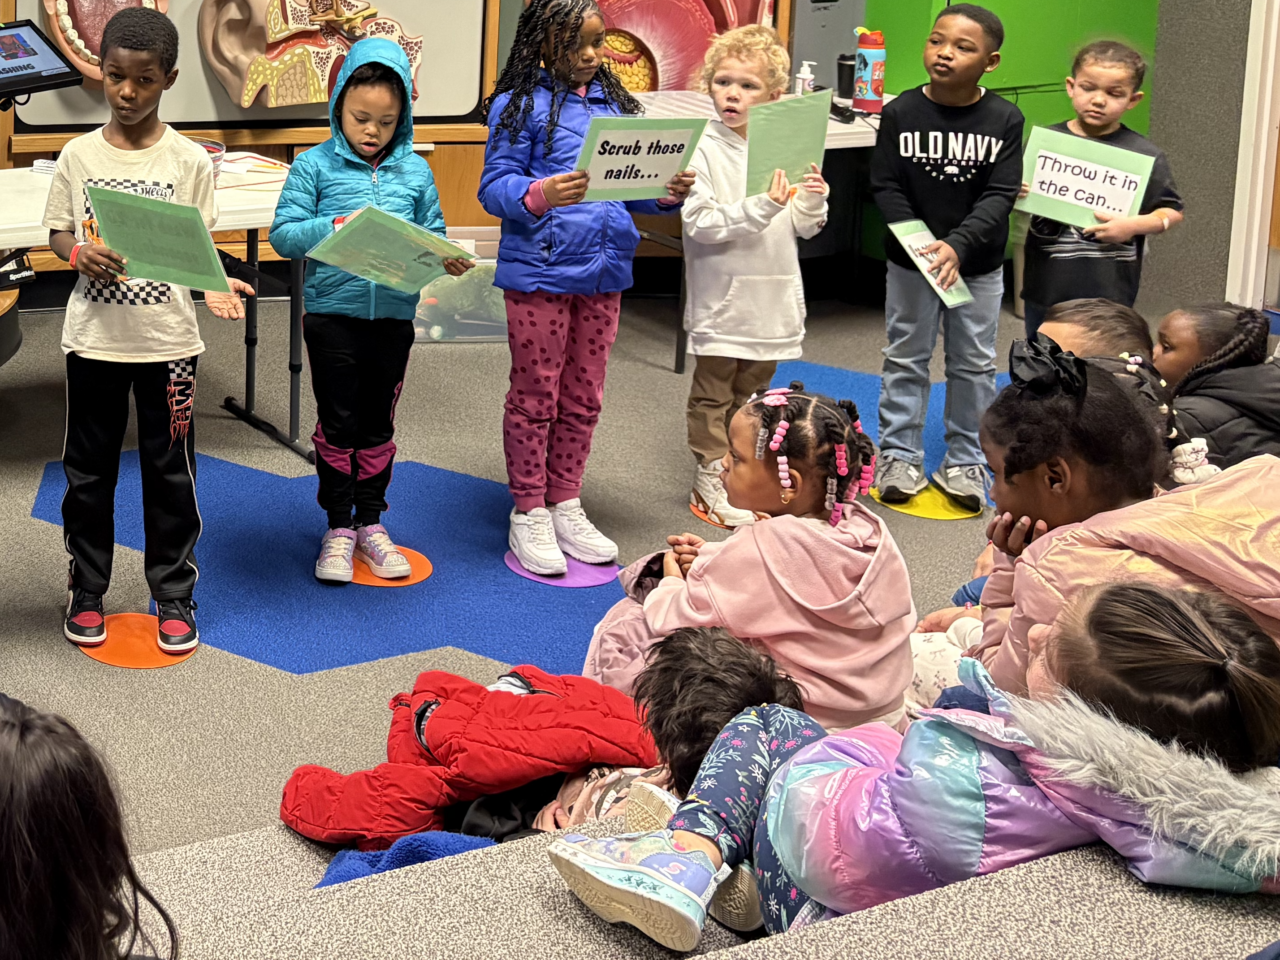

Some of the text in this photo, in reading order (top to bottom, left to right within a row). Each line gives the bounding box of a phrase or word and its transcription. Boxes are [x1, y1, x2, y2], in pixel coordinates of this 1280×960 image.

[597, 139, 685, 156] Scrub those
[899, 131, 1004, 163] OLD NAVY
[912, 157, 987, 166] CALIFORNIA
[603, 163, 659, 180] nails...
[1037, 154, 1138, 192] Throw it in
[1037, 180, 1070, 197] the
